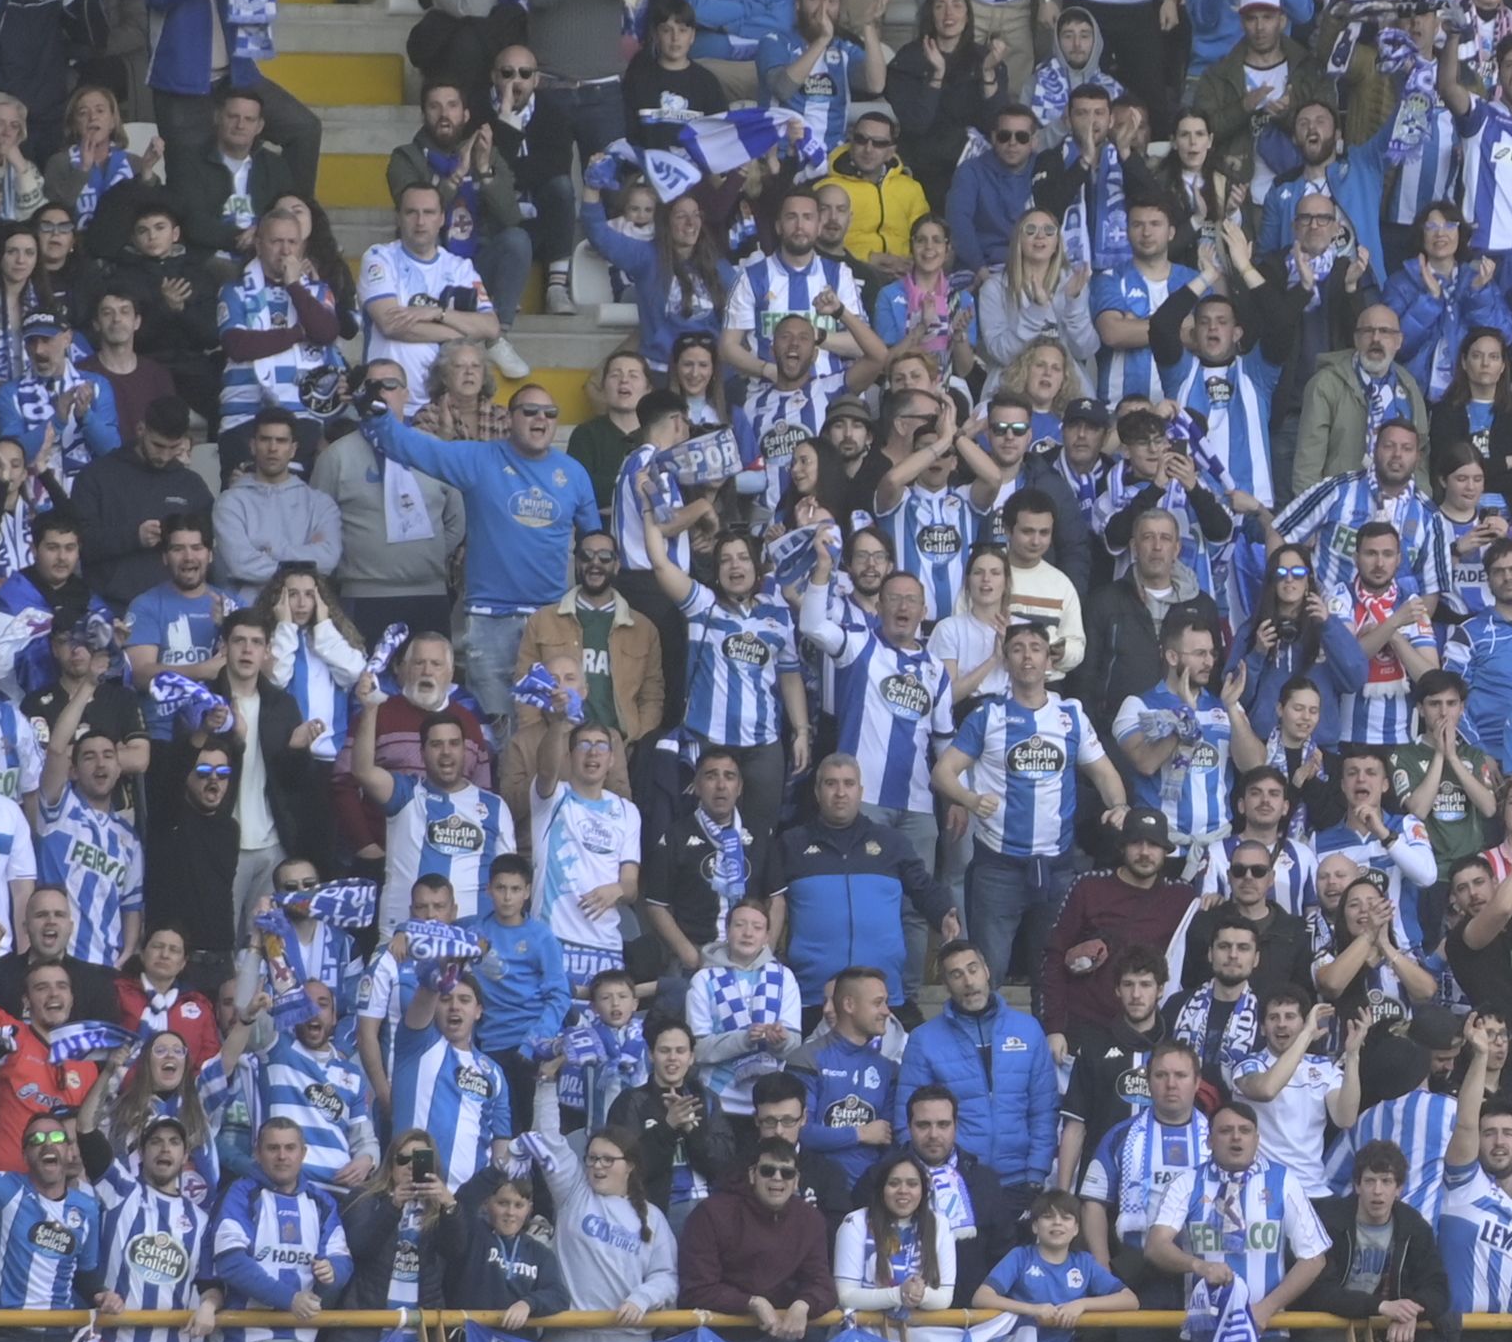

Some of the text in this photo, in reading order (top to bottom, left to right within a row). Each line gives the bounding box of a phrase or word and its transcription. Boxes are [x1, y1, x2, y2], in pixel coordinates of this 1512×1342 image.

[886, 678, 928, 695] Estrella
[885, 690, 927, 708] Galicia
[1013, 746, 1059, 758] Estrella
[1014, 757, 1056, 769] Galicia
[430, 834, 475, 848] Galicia
[133, 1241, 183, 1263] Estrella
[133, 1253, 185, 1273] Galicia
